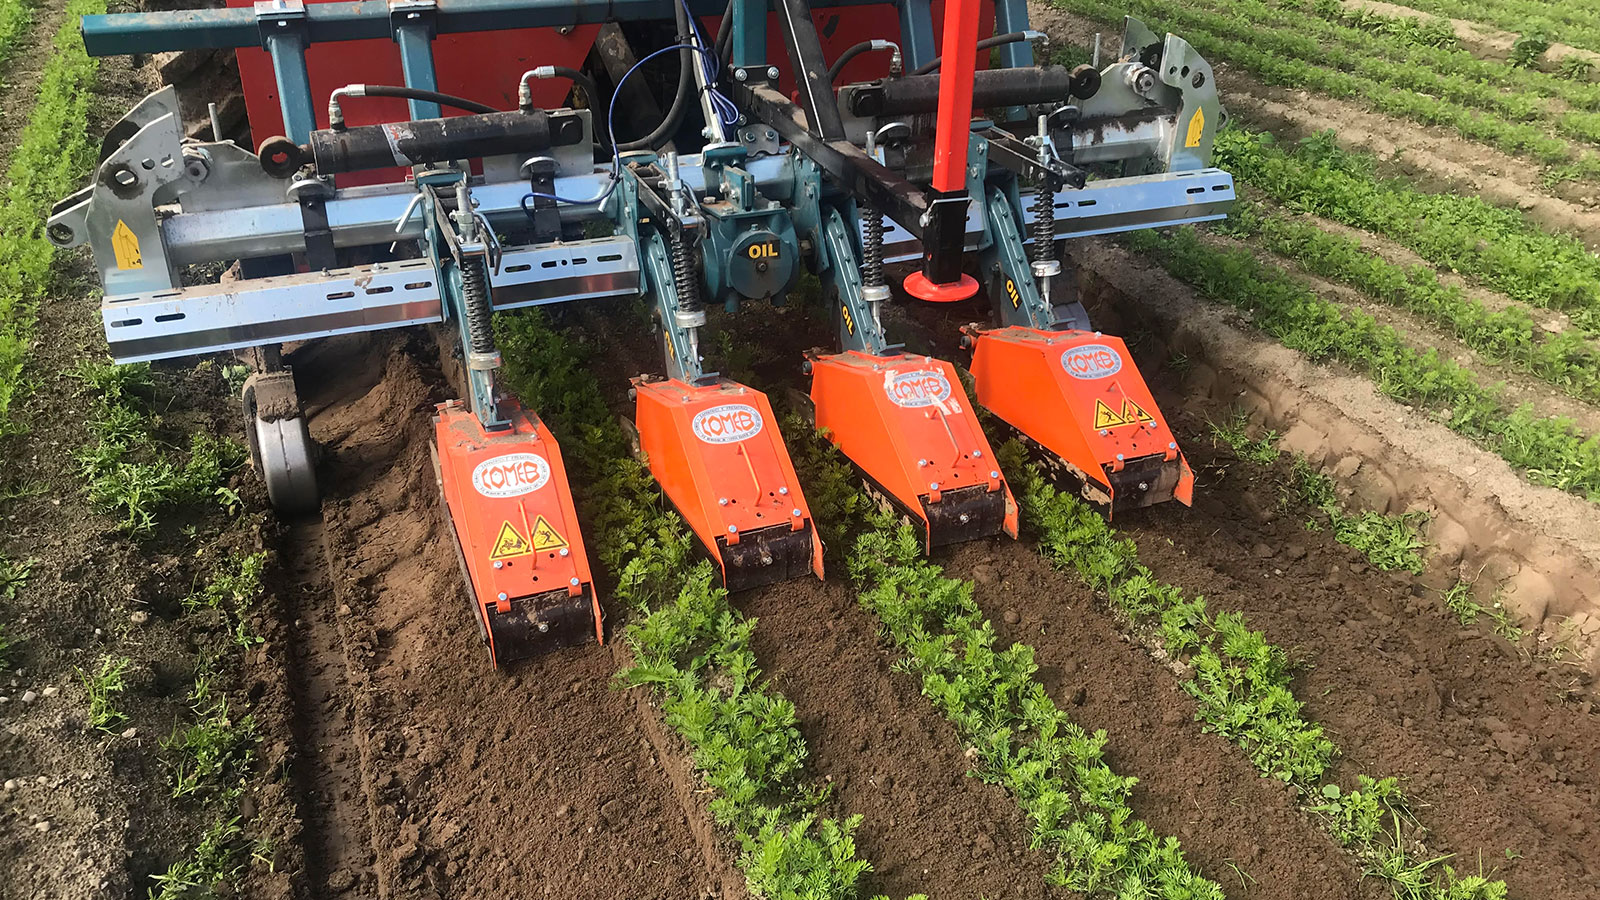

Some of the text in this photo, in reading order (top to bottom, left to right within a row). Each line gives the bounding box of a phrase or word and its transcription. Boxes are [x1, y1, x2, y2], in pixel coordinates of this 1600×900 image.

[748, 243, 778, 259] OIL
[1006, 279, 1019, 308] OIL
[842, 305, 853, 335] OIL
[1067, 350, 1115, 373] COMEB
[700, 410, 755, 437] COMEB
[481, 461, 541, 490] COMEB
